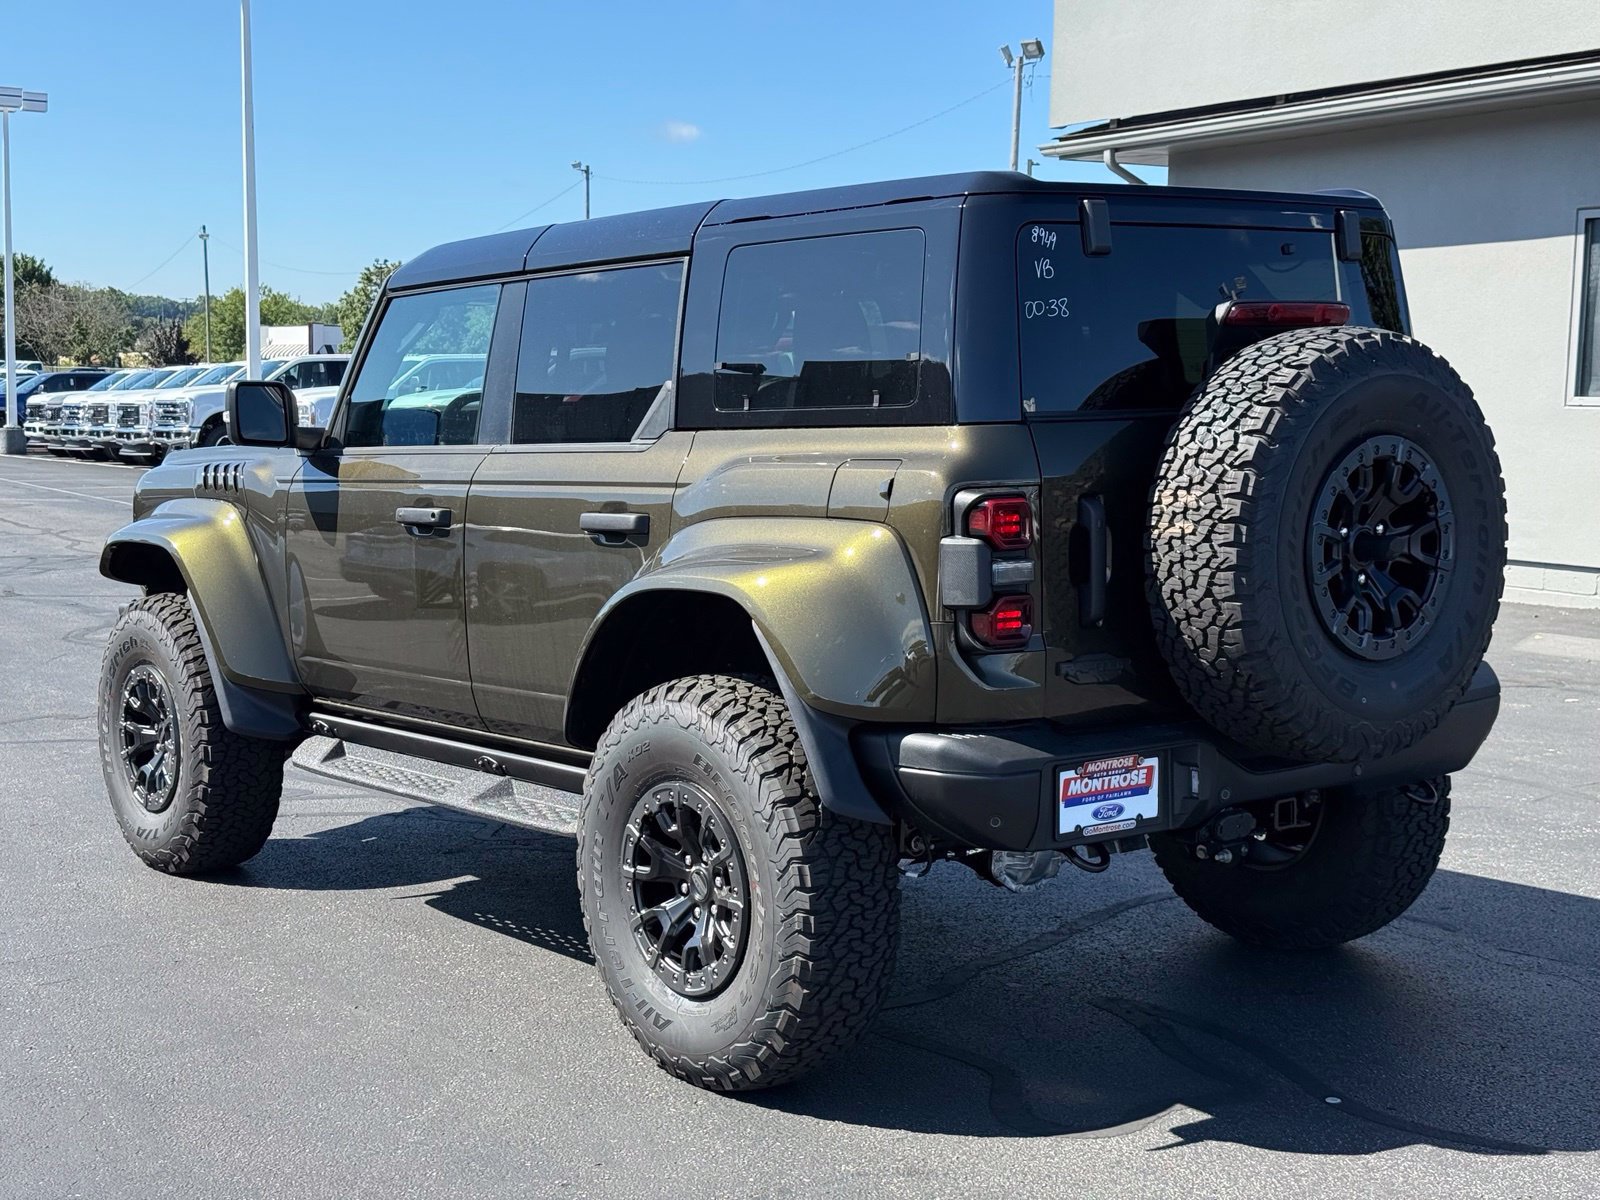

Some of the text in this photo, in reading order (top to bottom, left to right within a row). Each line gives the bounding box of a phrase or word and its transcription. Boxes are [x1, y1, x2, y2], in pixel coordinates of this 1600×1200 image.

[1031, 225, 1057, 250] 8949
[1034, 257, 1055, 279] VB
[1086, 756, 1135, 773] MONTROSE
[1067, 769, 1148, 796] MONTROSE
[1106, 791, 1132, 799] FAIRLAWN
[1097, 805, 1119, 819] Ford
[1084, 821, 1136, 836] GoMontrose.com
